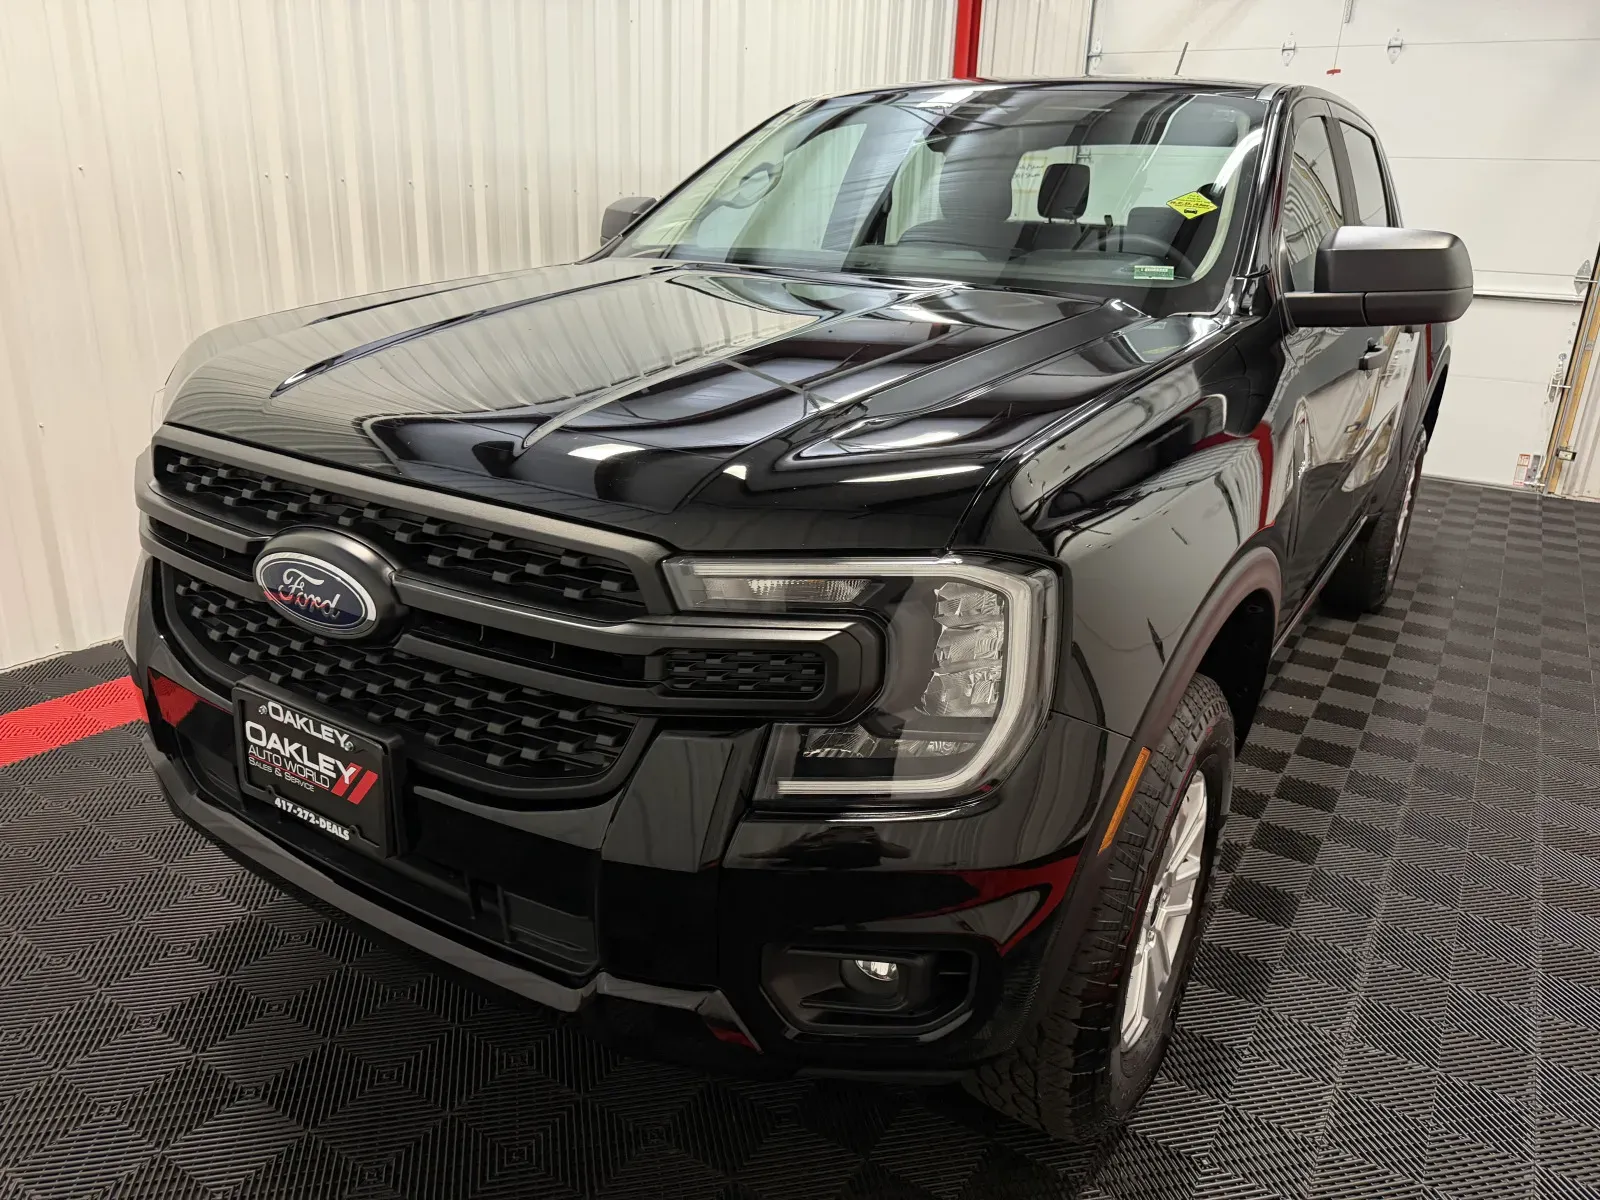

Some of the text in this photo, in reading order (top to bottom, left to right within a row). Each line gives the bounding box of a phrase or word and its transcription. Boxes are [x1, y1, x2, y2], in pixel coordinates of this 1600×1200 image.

[278, 568, 340, 620] Ford
[267, 701, 350, 748] OAKLEY
[245, 720, 357, 785] OAKLEY
[248, 744, 330, 788] AUTO WORLD
[248, 757, 315, 792] SALES & SERVICE
[274, 797, 350, 841] 417-272-DEALS
